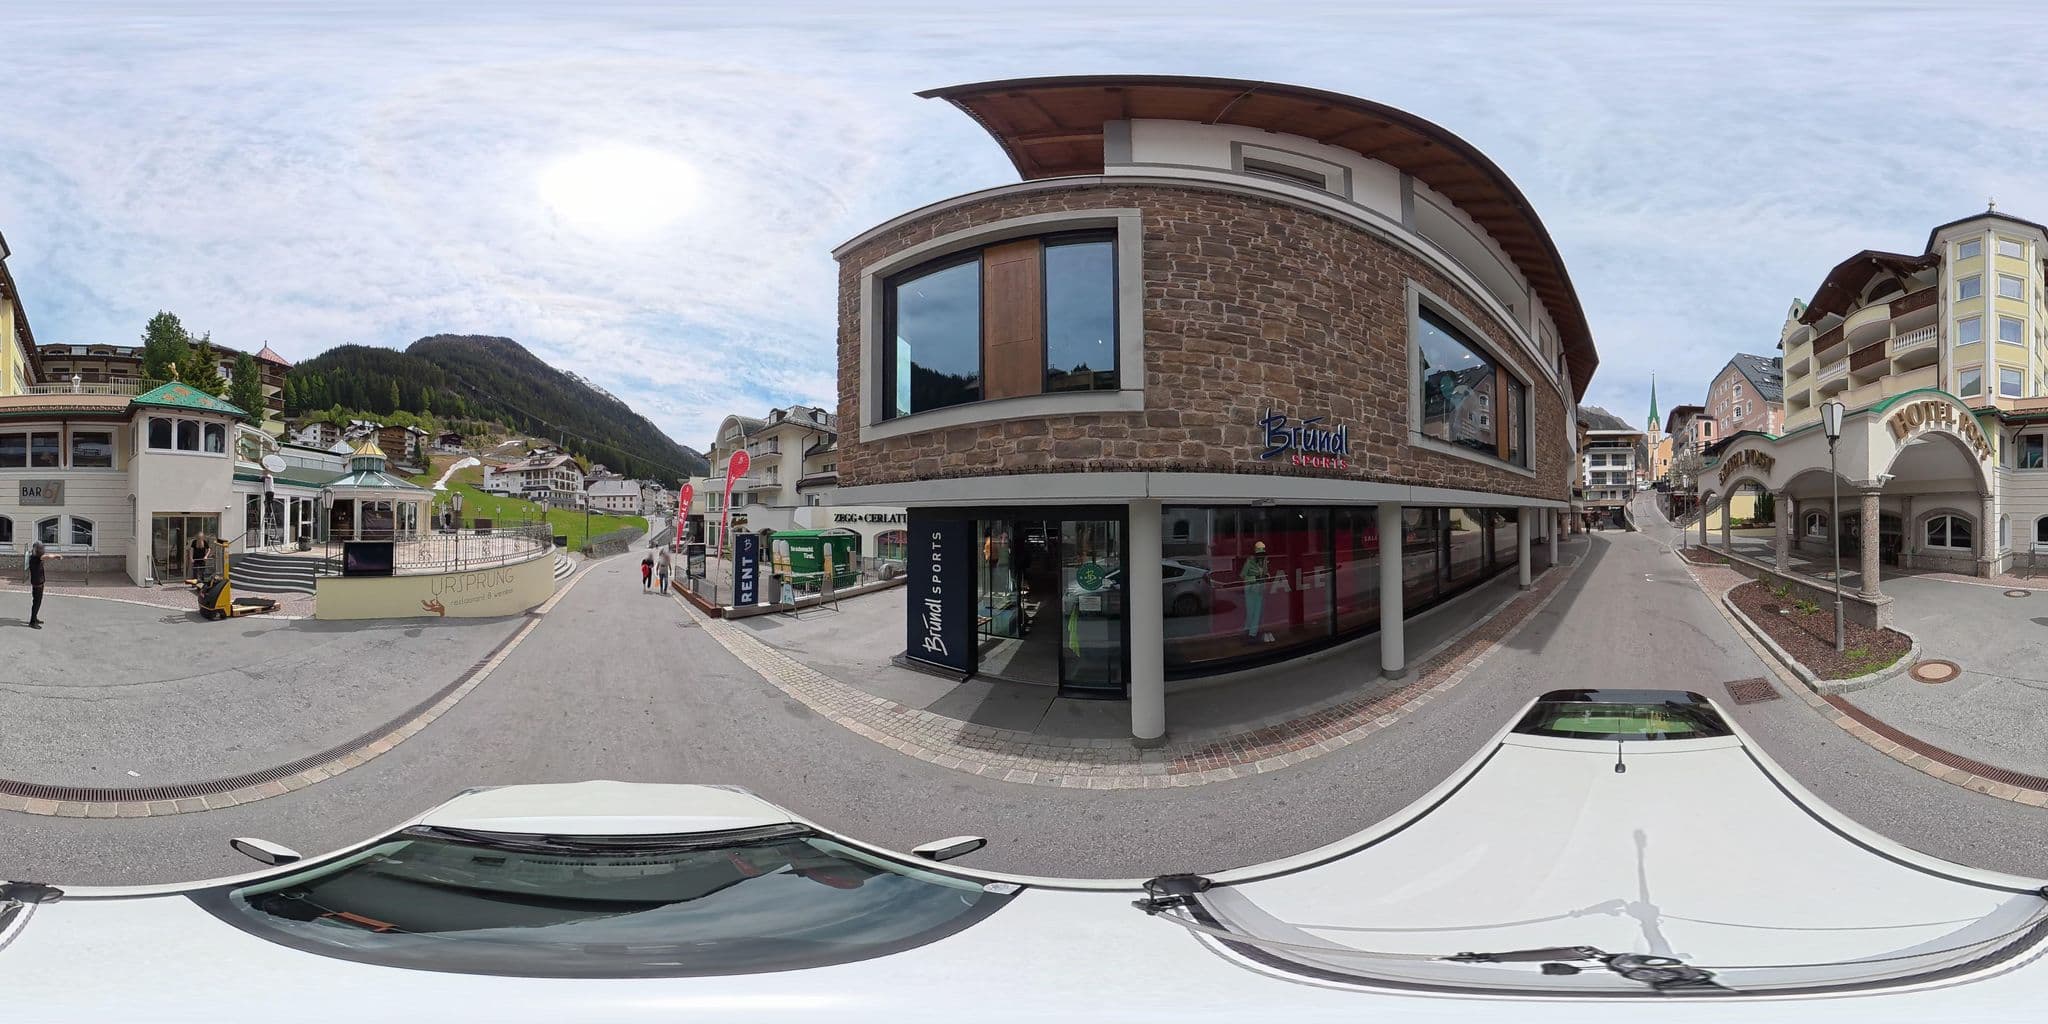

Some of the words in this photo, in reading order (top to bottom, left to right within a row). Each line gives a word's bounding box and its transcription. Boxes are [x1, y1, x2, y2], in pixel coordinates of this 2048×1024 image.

[1885, 401, 1957, 443] HOTEL
[1959, 412, 1991, 461] POST
[1292, 454, 1349, 470] SPORTS
[22, 486, 42, 497] BAR
[834, 513, 857, 523] ZEGG
[932, 531, 942, 595] SPORTS
[431, 568, 514, 595] URSPRUNG
[741, 556, 753, 603] RENT
[1269, 565, 1327, 594] ALE
